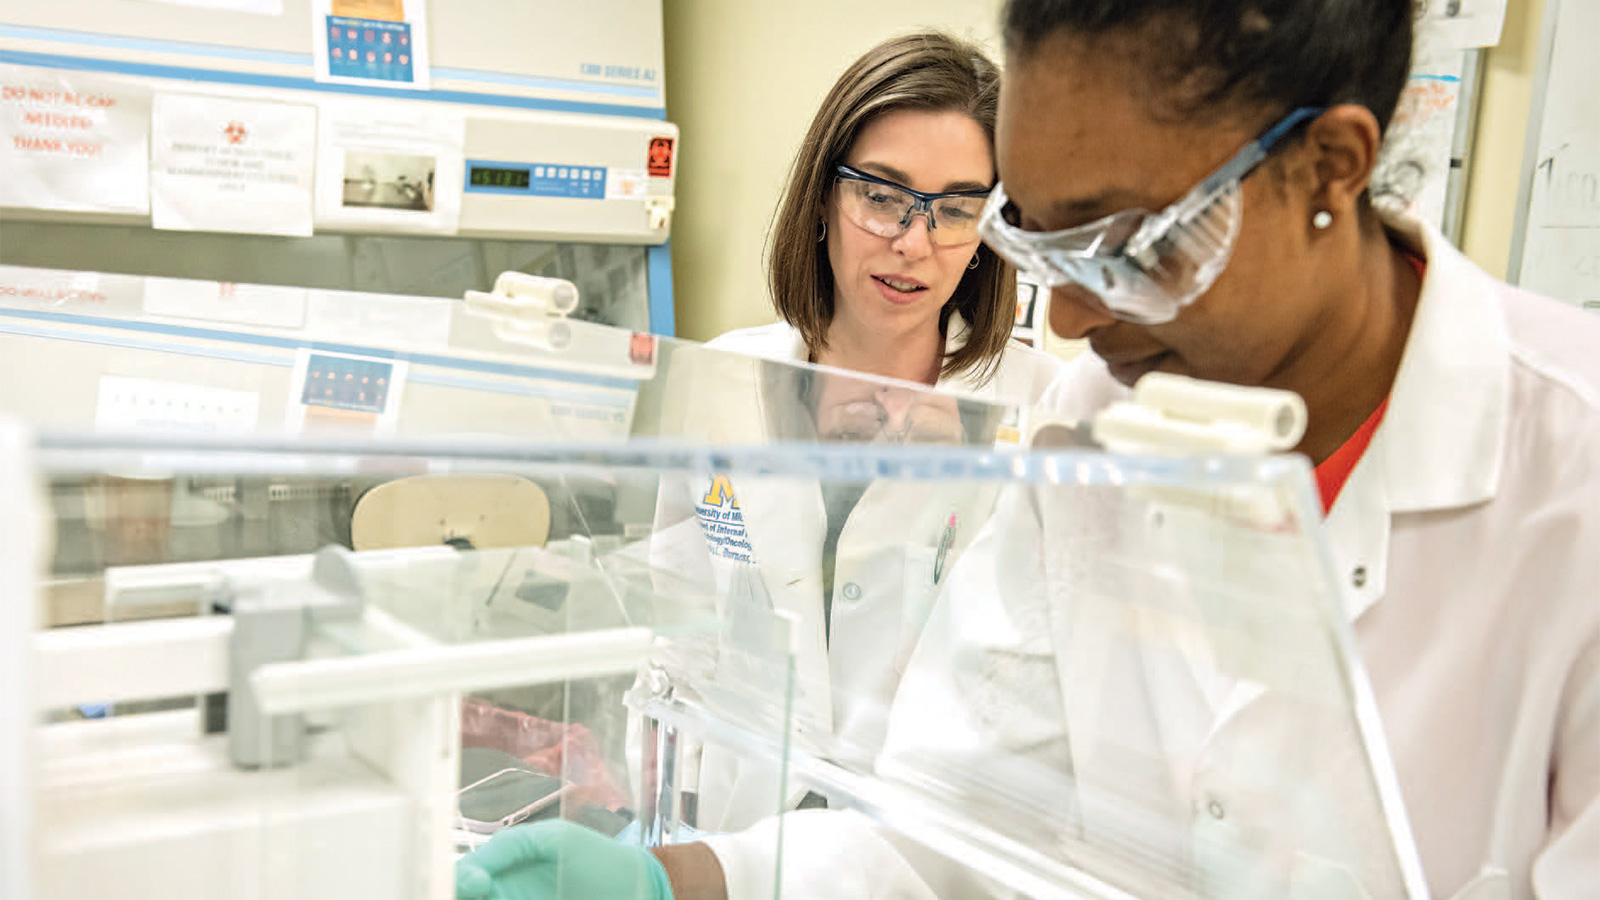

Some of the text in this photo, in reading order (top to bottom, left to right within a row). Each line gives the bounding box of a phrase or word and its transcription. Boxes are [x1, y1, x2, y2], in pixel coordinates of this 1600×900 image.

[13, 136, 61, 152] THANK
[722, 511, 731, 521] of
[717, 524, 745, 537] Internal
